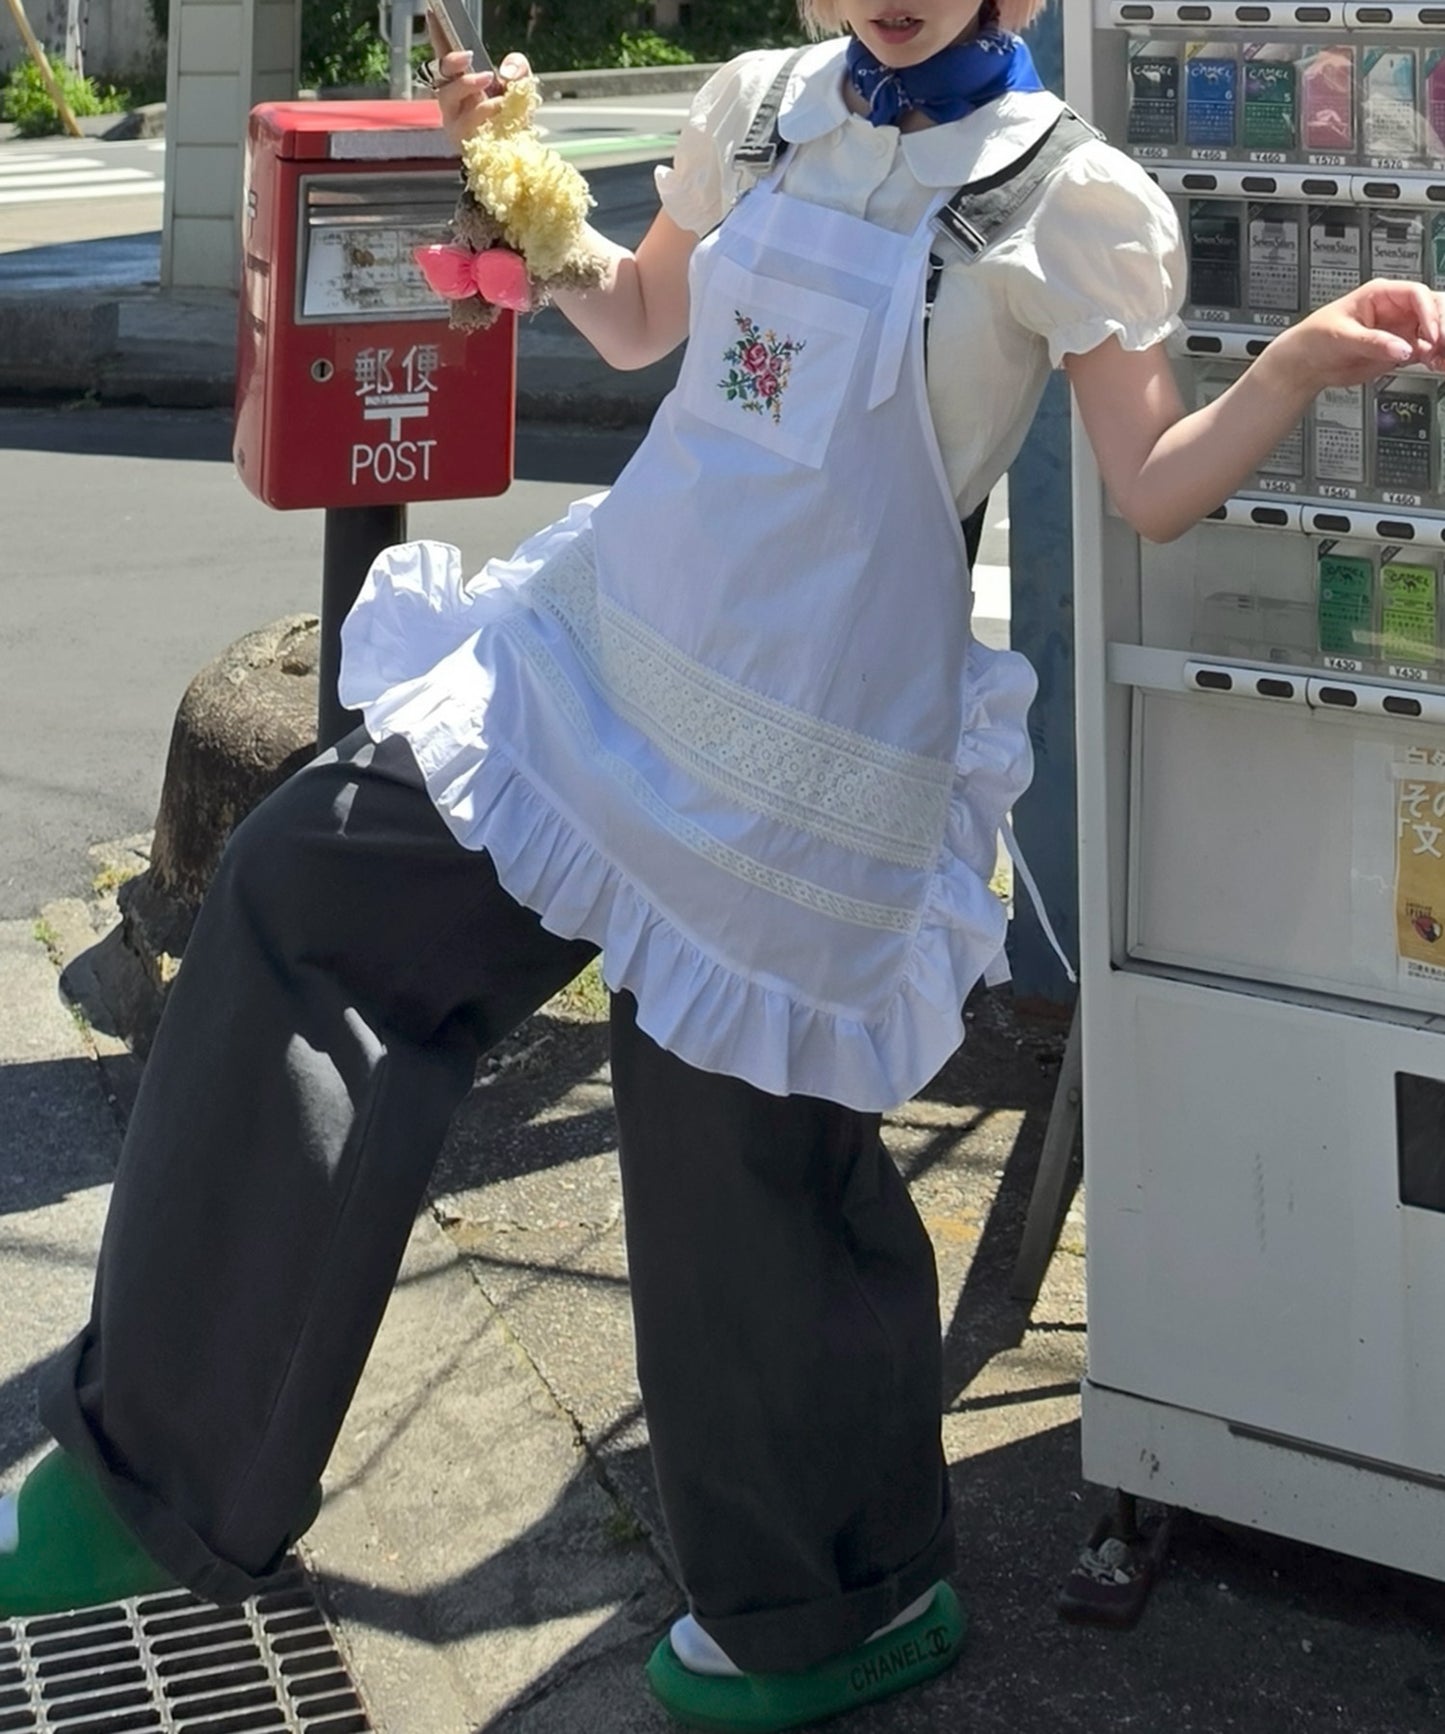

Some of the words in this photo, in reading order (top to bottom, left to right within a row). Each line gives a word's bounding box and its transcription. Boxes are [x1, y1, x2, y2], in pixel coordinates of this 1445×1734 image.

[1133, 64, 1173, 76] CAMEL
[1191, 63, 1232, 77] CAMEL
[1249, 67, 1289, 80] CAMEL
[354, 344, 440, 397] 郵便
[1380, 400, 1425, 416] CAMEL
[351, 439, 437, 486] POST
[1330, 658, 1357, 671] ¥430
[1395, 667, 1423, 680] ¥430
[850, 1641, 927, 1692] CHANEL
